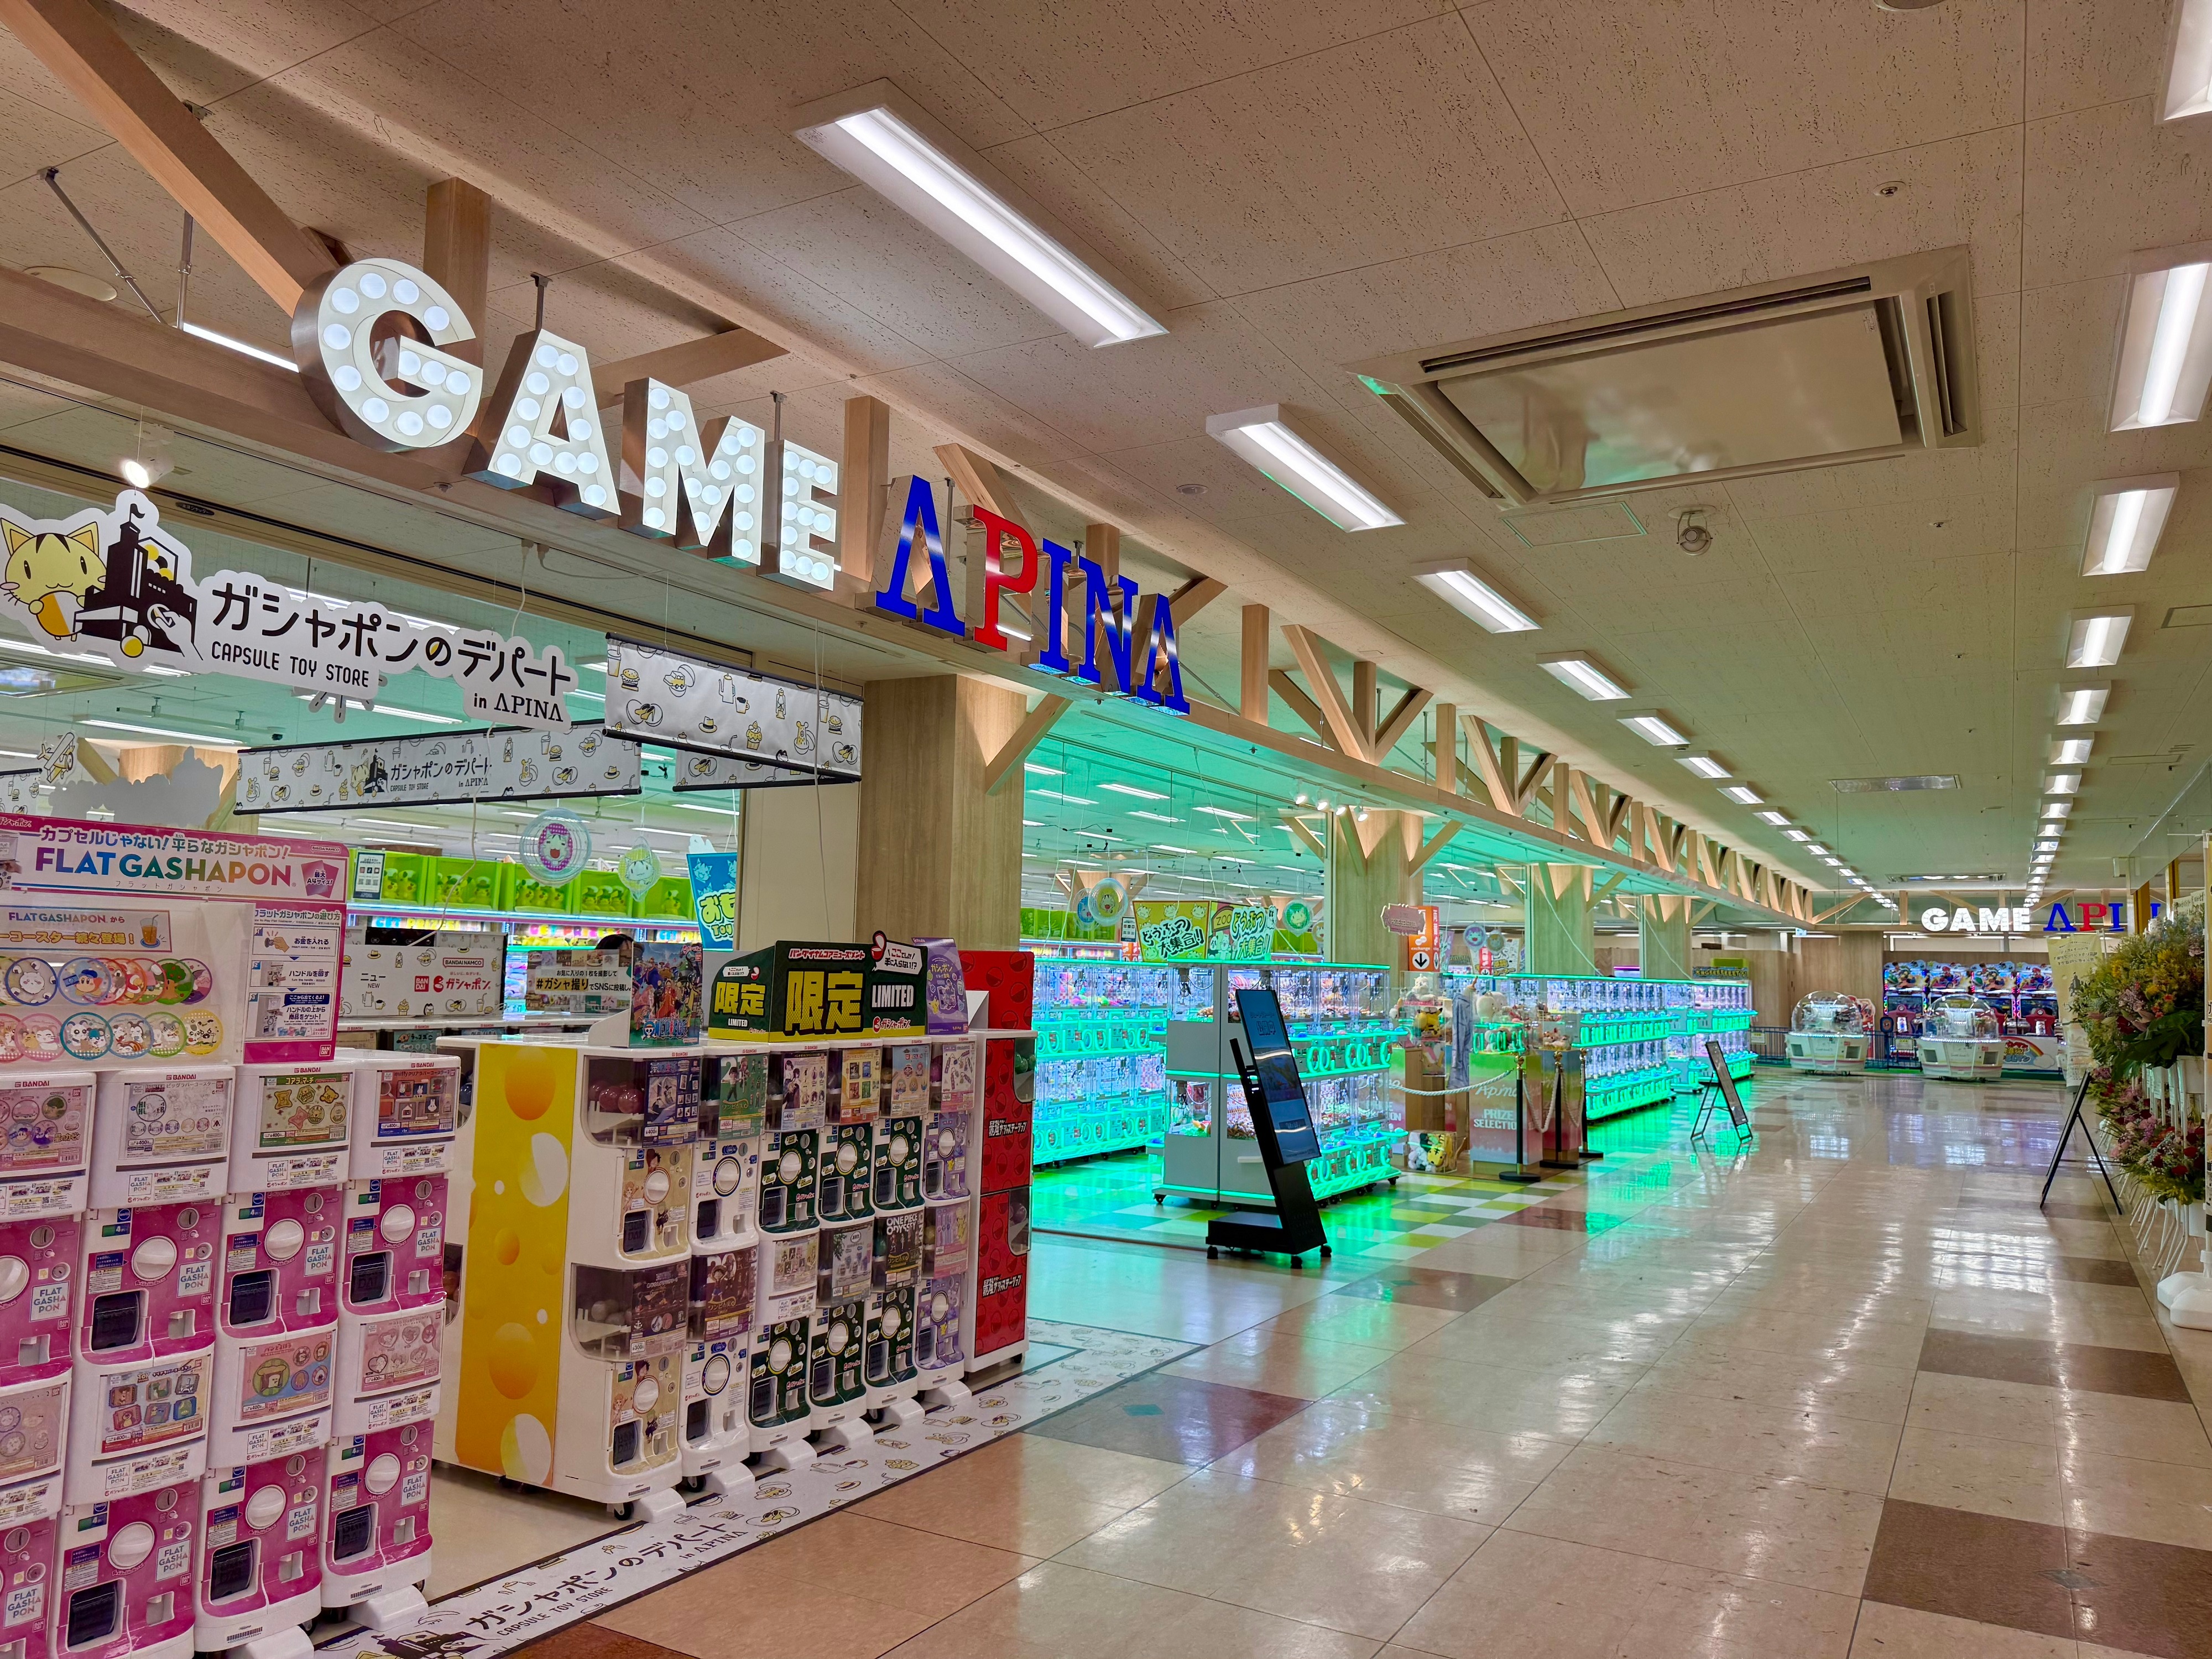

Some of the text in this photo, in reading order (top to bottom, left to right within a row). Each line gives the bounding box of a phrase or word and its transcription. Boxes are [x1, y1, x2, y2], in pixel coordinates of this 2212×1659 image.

[296, 257, 839, 592] GAME
[211, 582, 571, 696] ガシャポンのデパート
[211, 641, 369, 688] CAPSULE TOY STORE
[474, 693, 487, 709] in
[390, 756, 492, 781] ガシャポンのデパート
[35, 847, 291, 887] FLAT GASHAPON
[9, 912, 38, 921] FLAT
[39, 913, 106, 924] GASHAPON
[1217, 914, 1232, 926] ZOO
[1921, 907, 2030, 932] GAME
[1233, 910, 1266, 939] どうぶつ
[1142, 919, 1191, 946] どうぶつ
[1157, 928, 1204, 958] 大集合!!
[361, 972, 386, 982] ニュー
[446, 977, 491, 990] ガシャポン
[714, 982, 766, 1016] 限定
[785, 971, 863, 1031] 限定
[872, 984, 914, 1008] LIMITED
[728, 1018, 748, 1027] LIMITED
[880, 1016, 911, 1029] ガシャポン
[1484, 1109, 1514, 1120] PRIZE
[1473, 1118, 1517, 1130] SELECTIO
[886, 1213, 918, 1227] ONE PIECE
[418, 1237, 440, 1245] GASHA
[307, 1254, 332, 1262] GASHA
[186, 1265, 205, 1274] FLAT
[180, 1274, 209, 1282] GASHA
[40, 1287, 62, 1296] FLAT
[185, 1281, 203, 1290] PON
[34, 1294, 66, 1305] GASHA
[39, 1303, 60, 1313] PON
[406, 1475, 422, 1486] FLAT
[403, 1483, 426, 1494] GASHA
[406, 1489, 421, 1499] PON
[294, 1508, 311, 1518] FLAT
[289, 1514, 315, 1526] GASHA
[293, 1523, 310, 1533] PON
[165, 1545, 184, 1557] FLAT
[679, 1551, 693, 1560] in
[159, 1552, 188, 1566] GASHA
[163, 1561, 183, 1572] PON
[466, 1522, 728, 1630] ガシャポンのデパート
[14, 1588, 38, 1601] FLAT
[8, 1597, 41, 1611] GASHA
[13, 1606, 35, 1619] PON
[497, 1587, 614, 1637] CAPSULE TOY STORE
